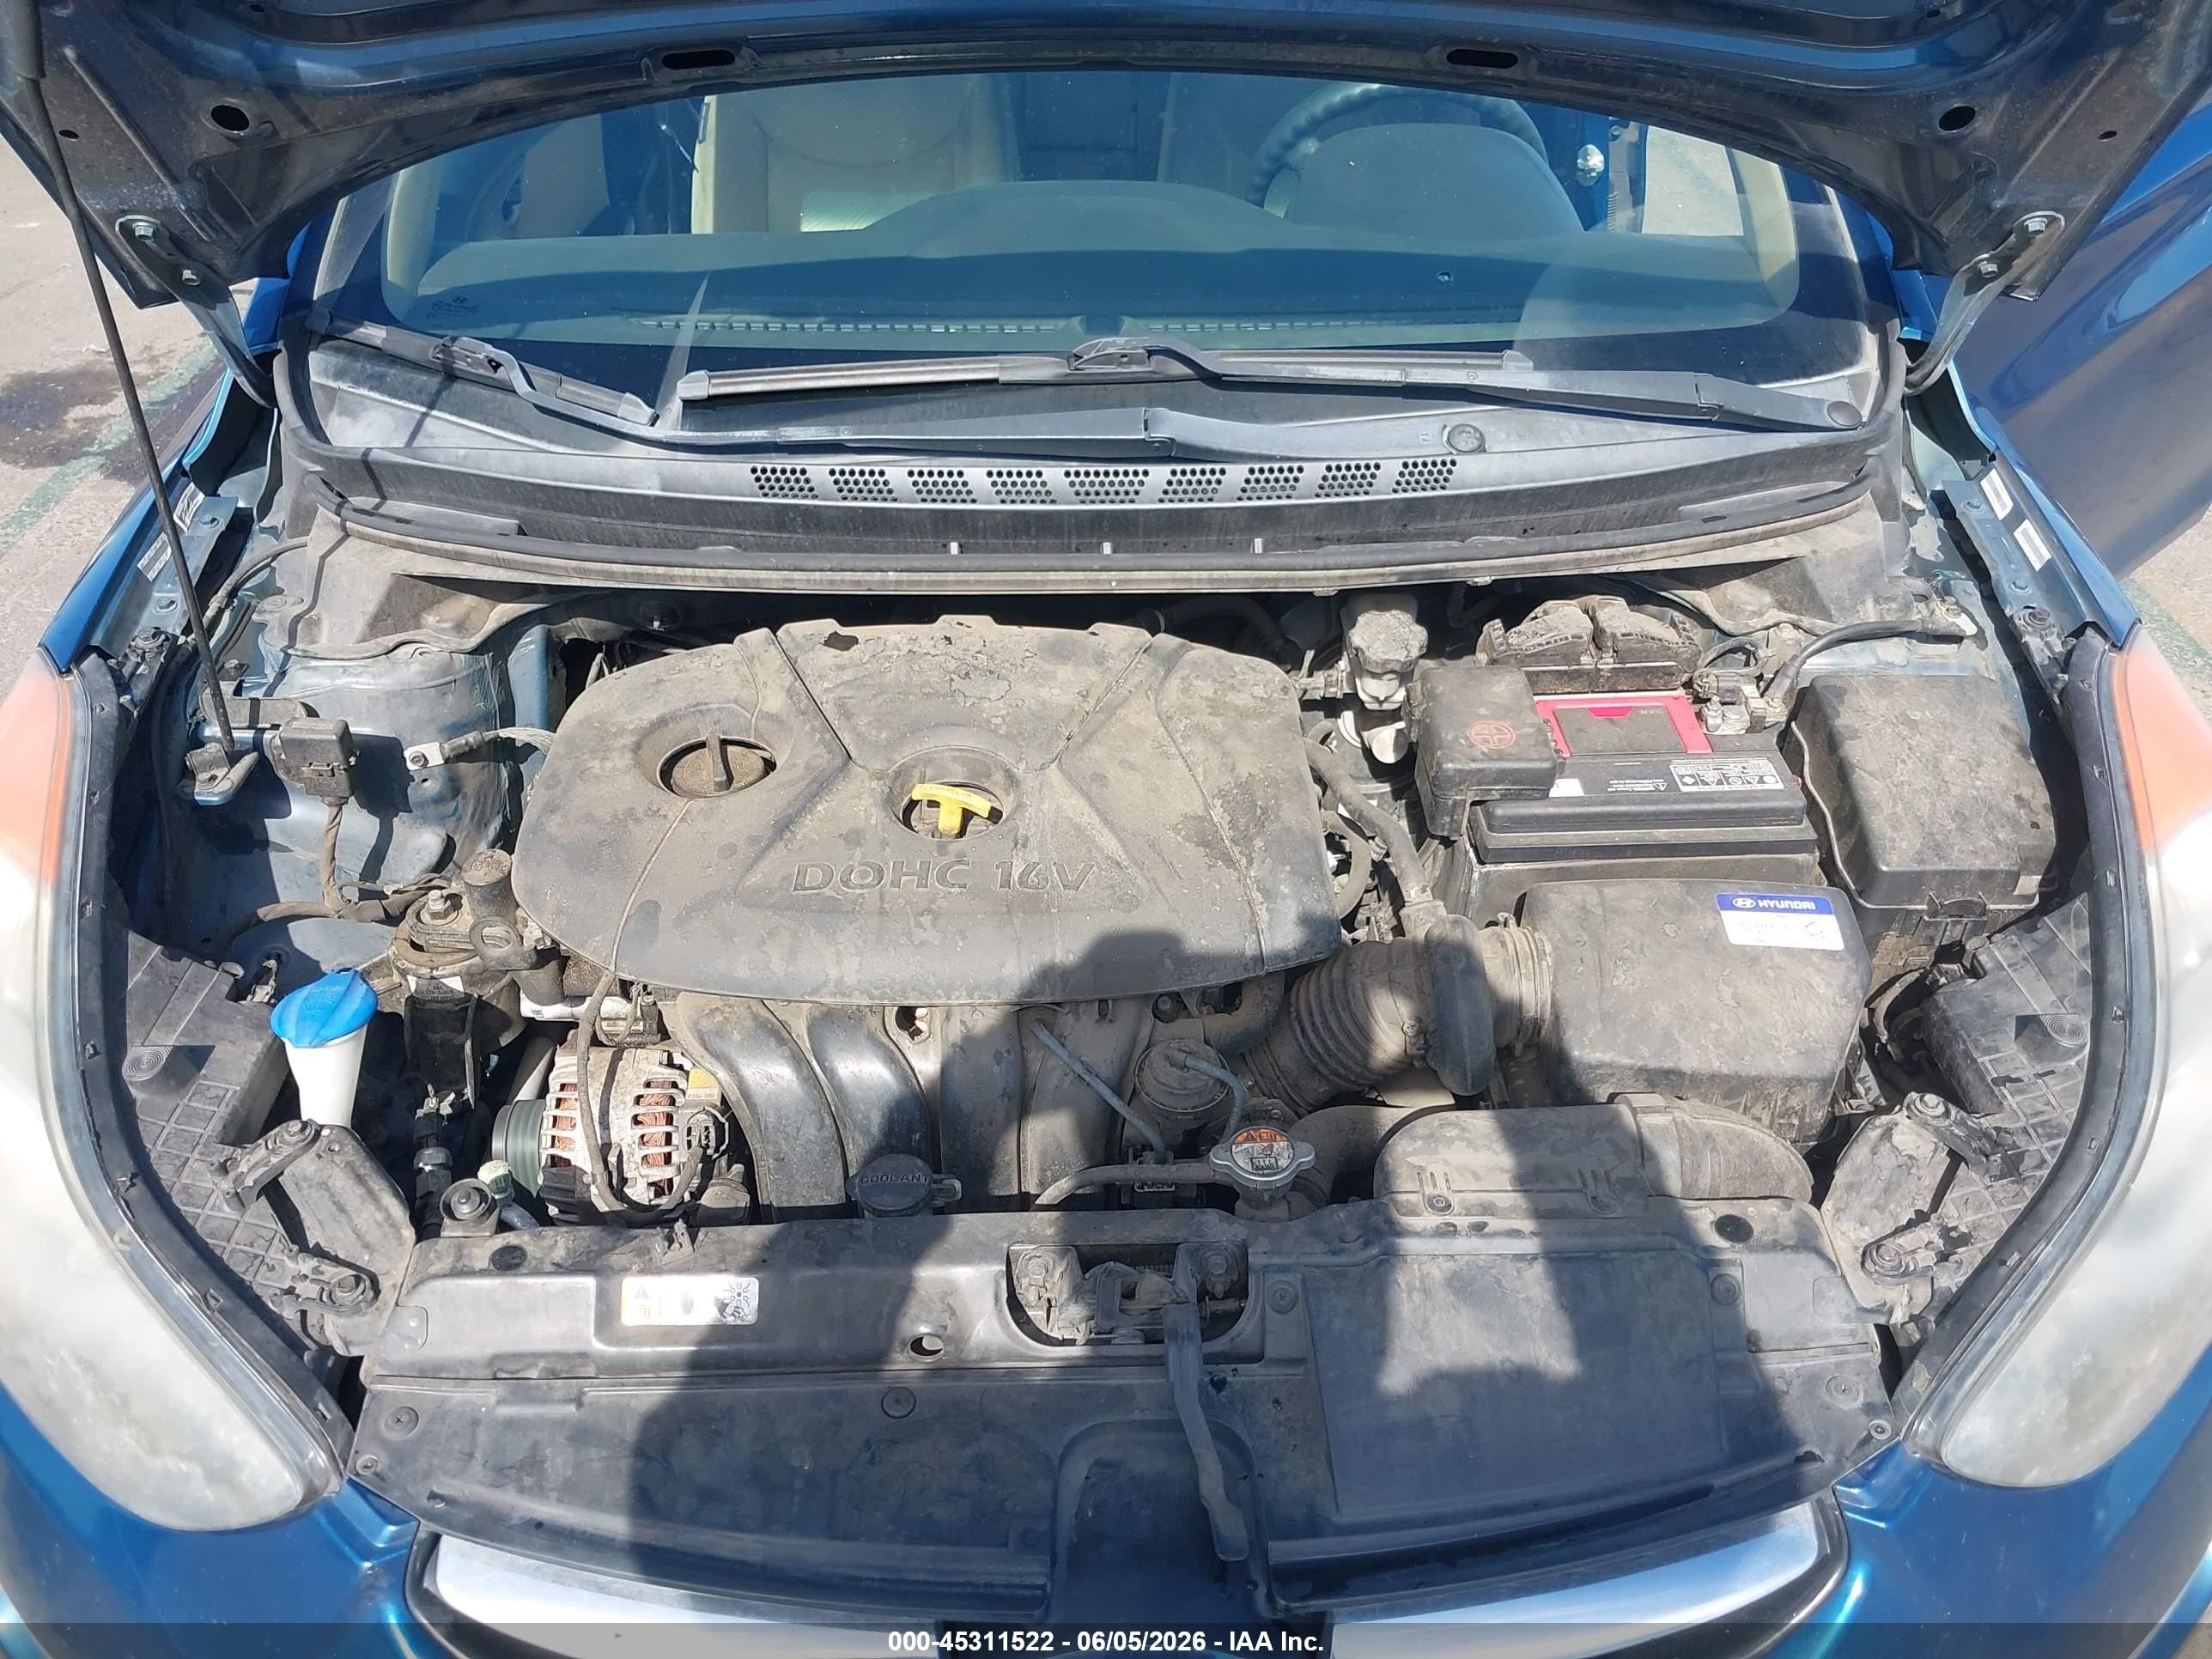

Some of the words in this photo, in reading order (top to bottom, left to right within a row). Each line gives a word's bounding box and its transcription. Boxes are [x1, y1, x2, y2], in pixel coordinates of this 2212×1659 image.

[792, 859, 971, 893] DOHC
[994, 859, 1096, 893] 16V
[1758, 899, 1816, 910] HYUNDAI
[860, 1173, 928, 1184] COOLANT
